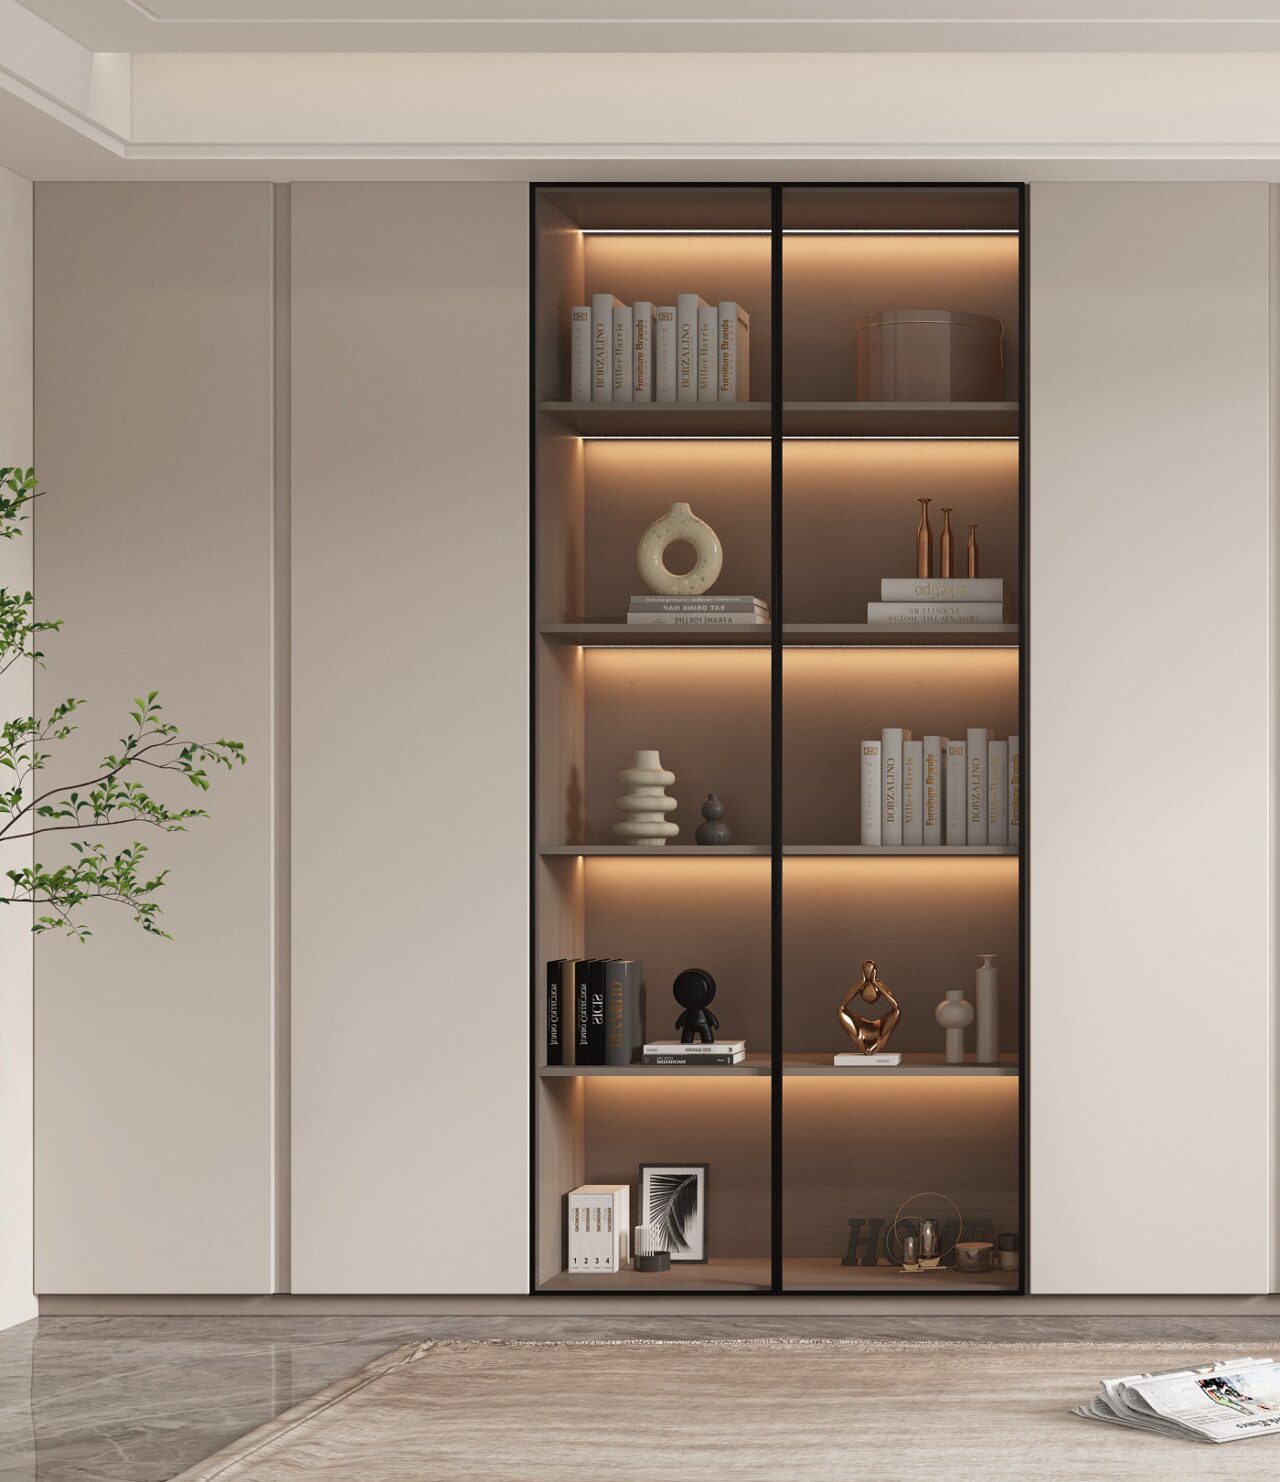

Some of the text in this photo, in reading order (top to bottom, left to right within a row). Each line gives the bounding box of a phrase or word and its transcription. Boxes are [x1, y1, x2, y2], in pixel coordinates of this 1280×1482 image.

[596, 323, 605, 388] BORZALINO
[615, 323, 624, 390] Miller Harris
[636, 319, 644, 391] Furniture Brands
[681, 323, 690, 388] BORZALINO
[700, 323, 709, 390] Miller Harris
[721, 319, 729, 391] Furniture Brands
[915, 584, 967, 599] arketipo
[886, 758, 895, 822] BORZALINO
[905, 757, 913, 824] Miller Harris
[926, 753, 934, 826] Furniture Brands
[971, 758, 981, 822] BORZALINO
